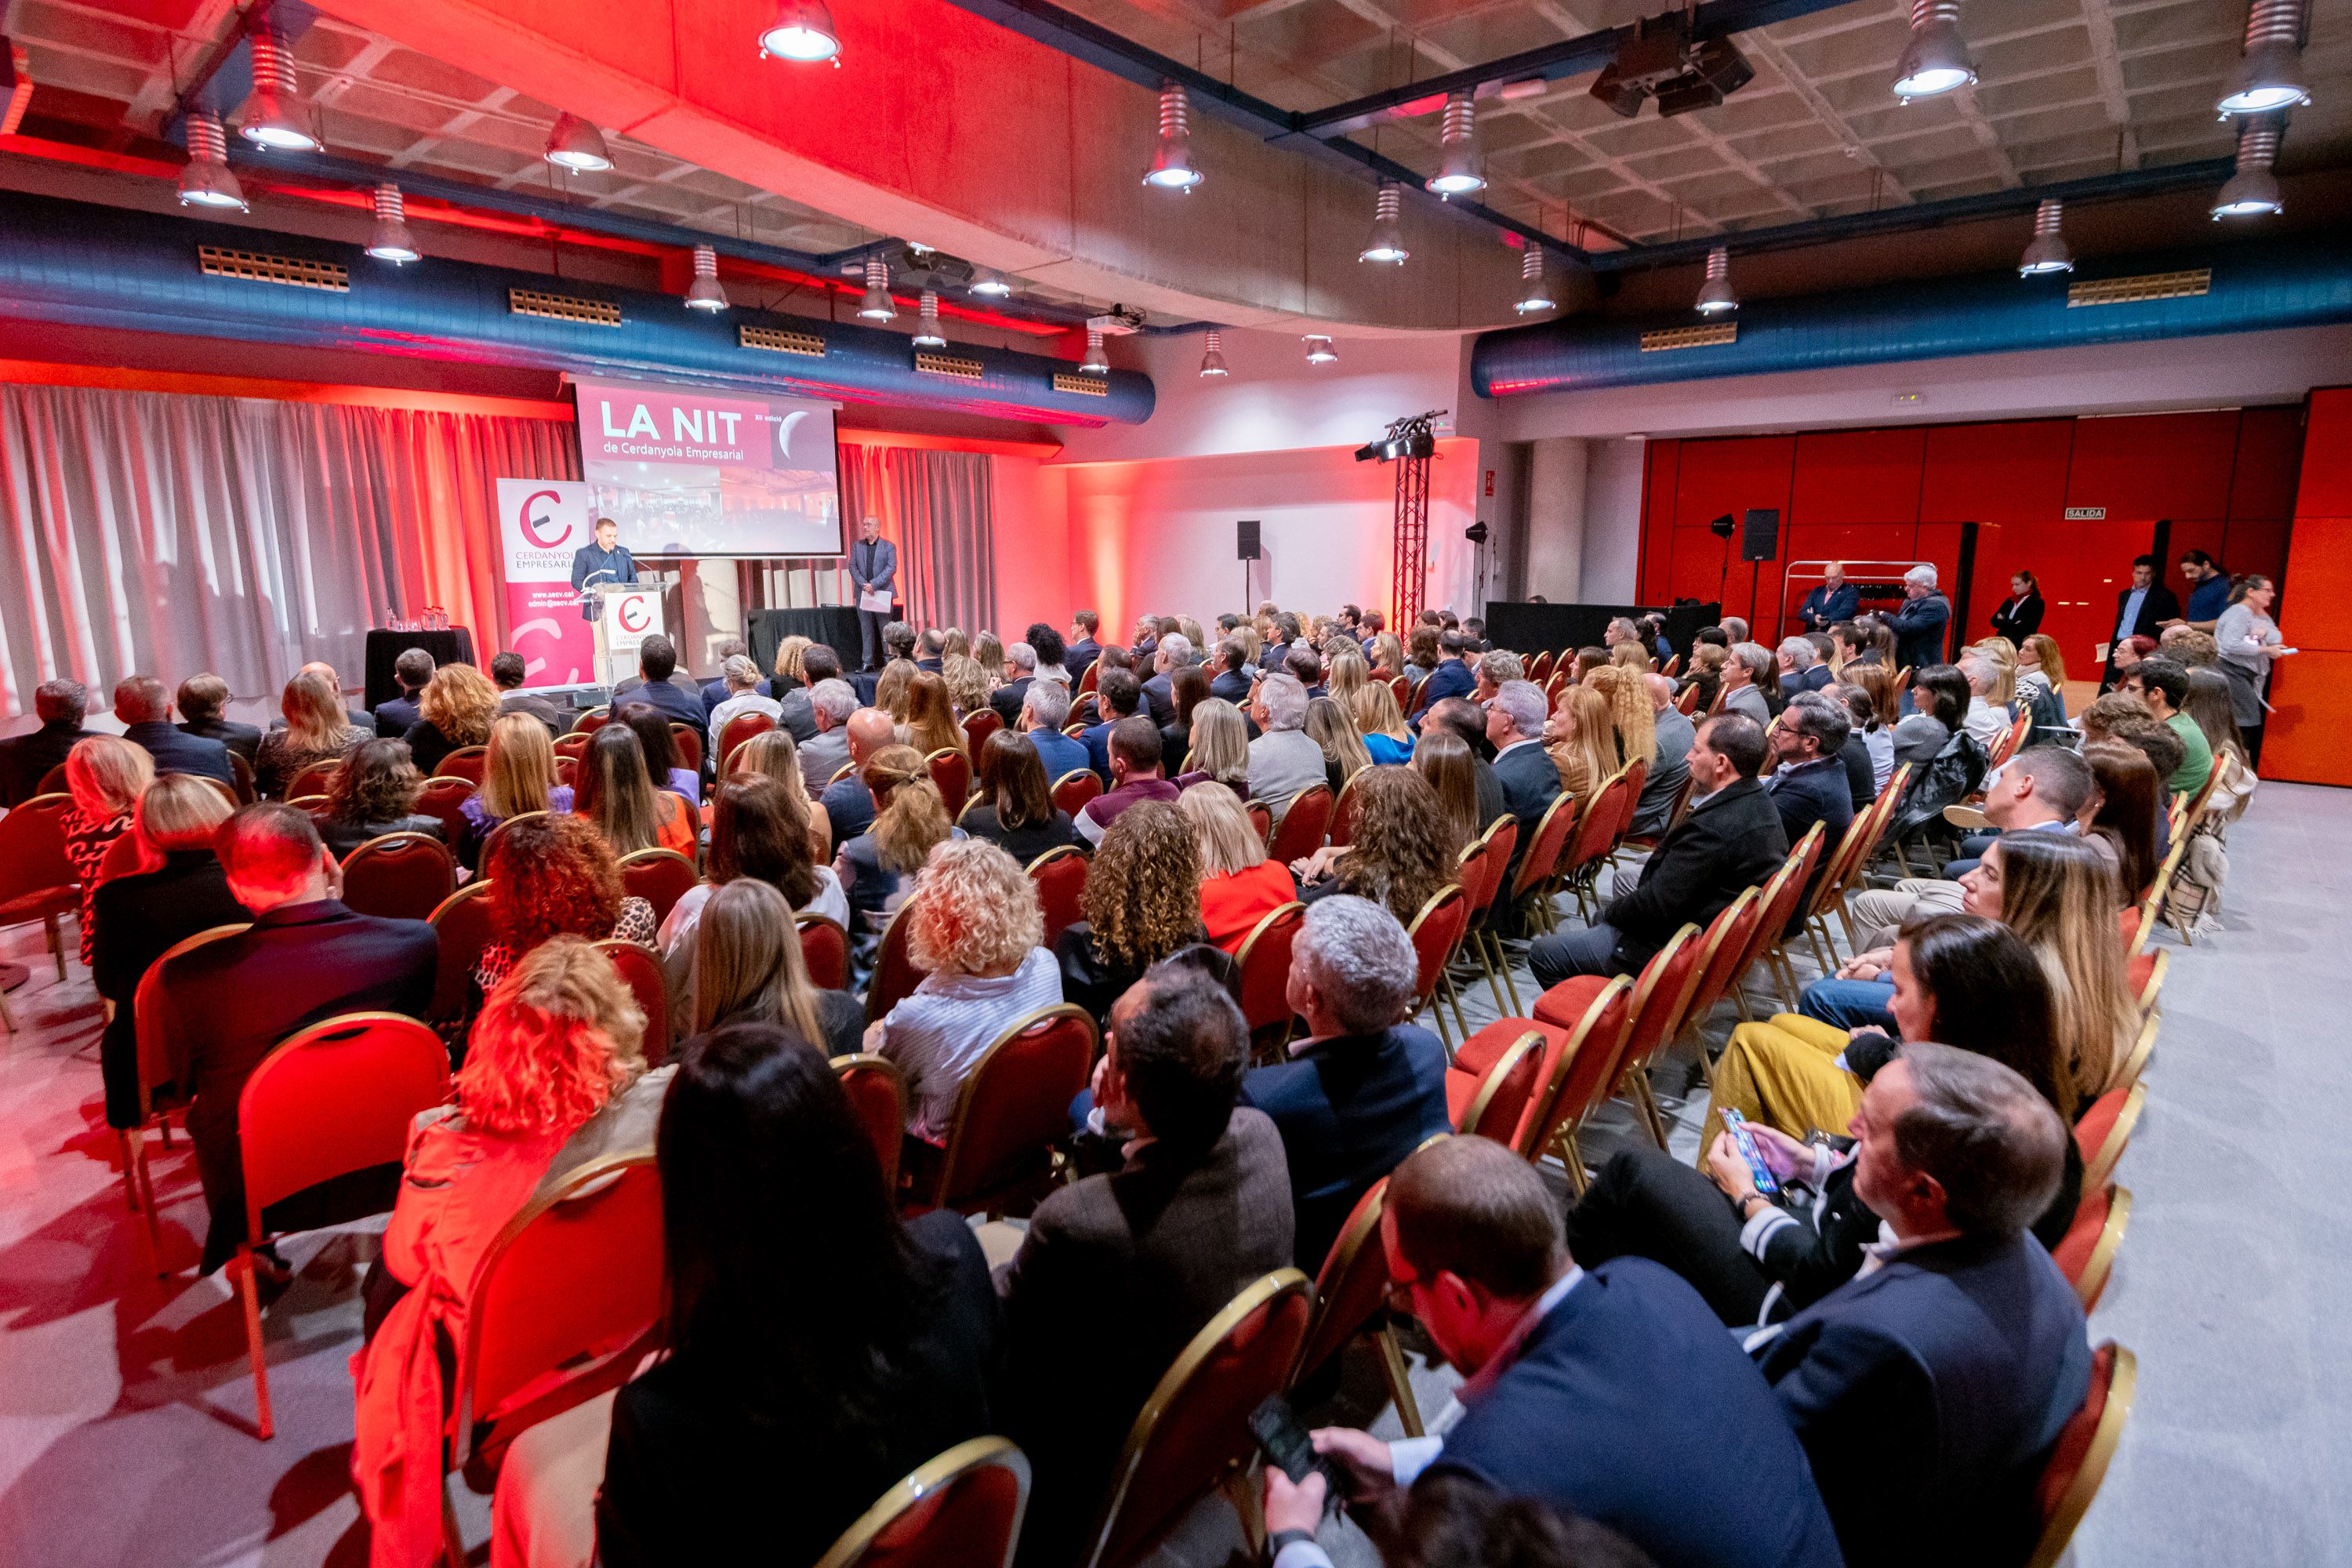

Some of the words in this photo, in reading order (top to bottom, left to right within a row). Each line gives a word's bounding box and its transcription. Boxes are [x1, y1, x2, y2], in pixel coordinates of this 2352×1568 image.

[601, 401, 661, 441] LA
[672, 407, 742, 445] NIT
[603, 441, 619, 453] de
[620, 442, 683, 459] Cerdanyola
[685, 446, 744, 461] Empresarial
[515, 551, 575, 560] CERDANYOL
[516, 560, 573, 569] EMPRESARI
